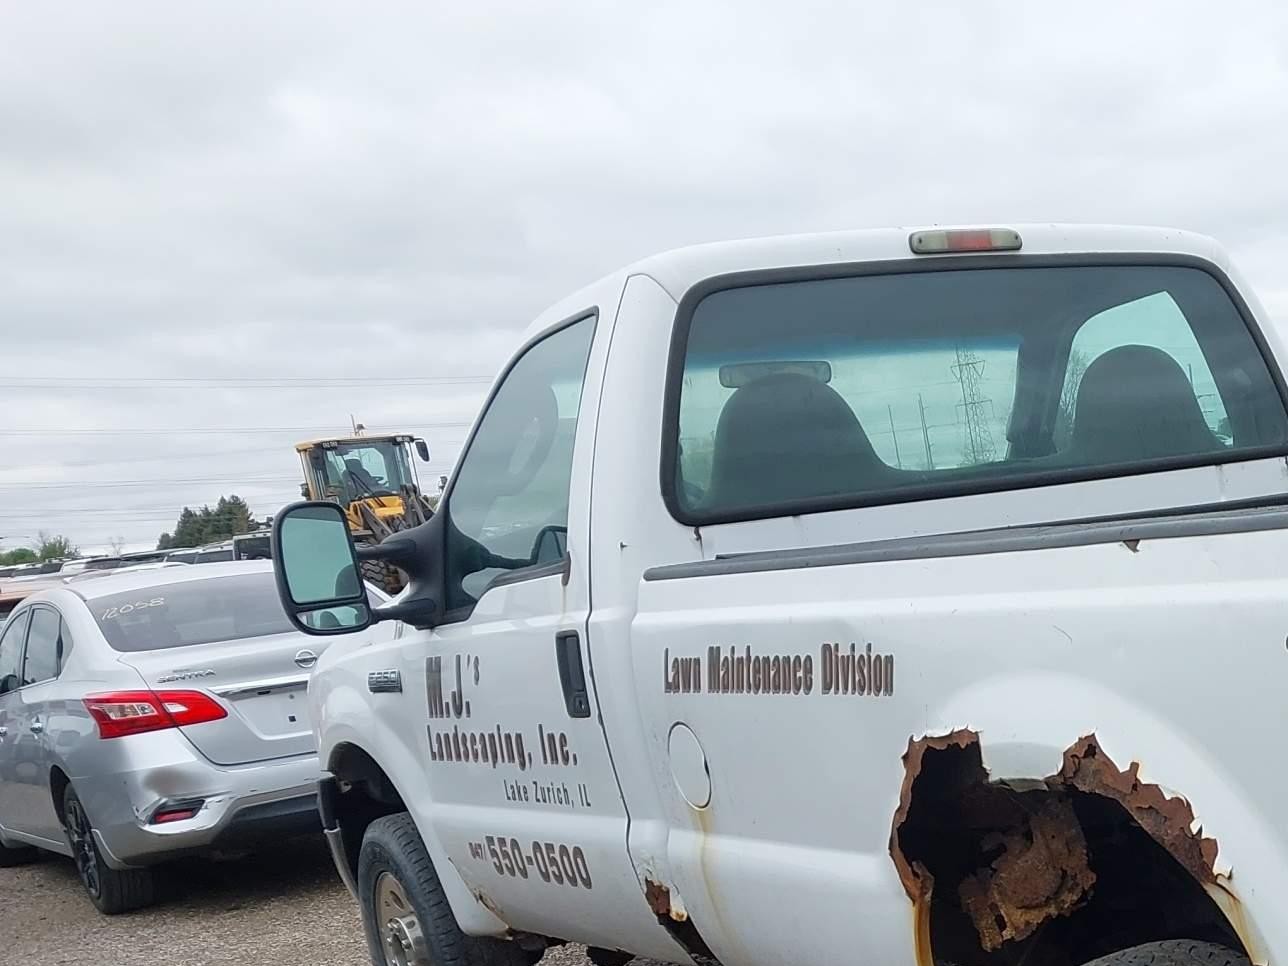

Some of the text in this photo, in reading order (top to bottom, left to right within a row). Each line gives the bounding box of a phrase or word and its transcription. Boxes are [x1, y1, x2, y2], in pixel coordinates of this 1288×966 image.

[663, 642, 894, 697] Lawn Maintenance Division
[426, 723, 578, 771] Landscaping, Inc.
[503, 779, 592, 808] Lake Zurich, IL
